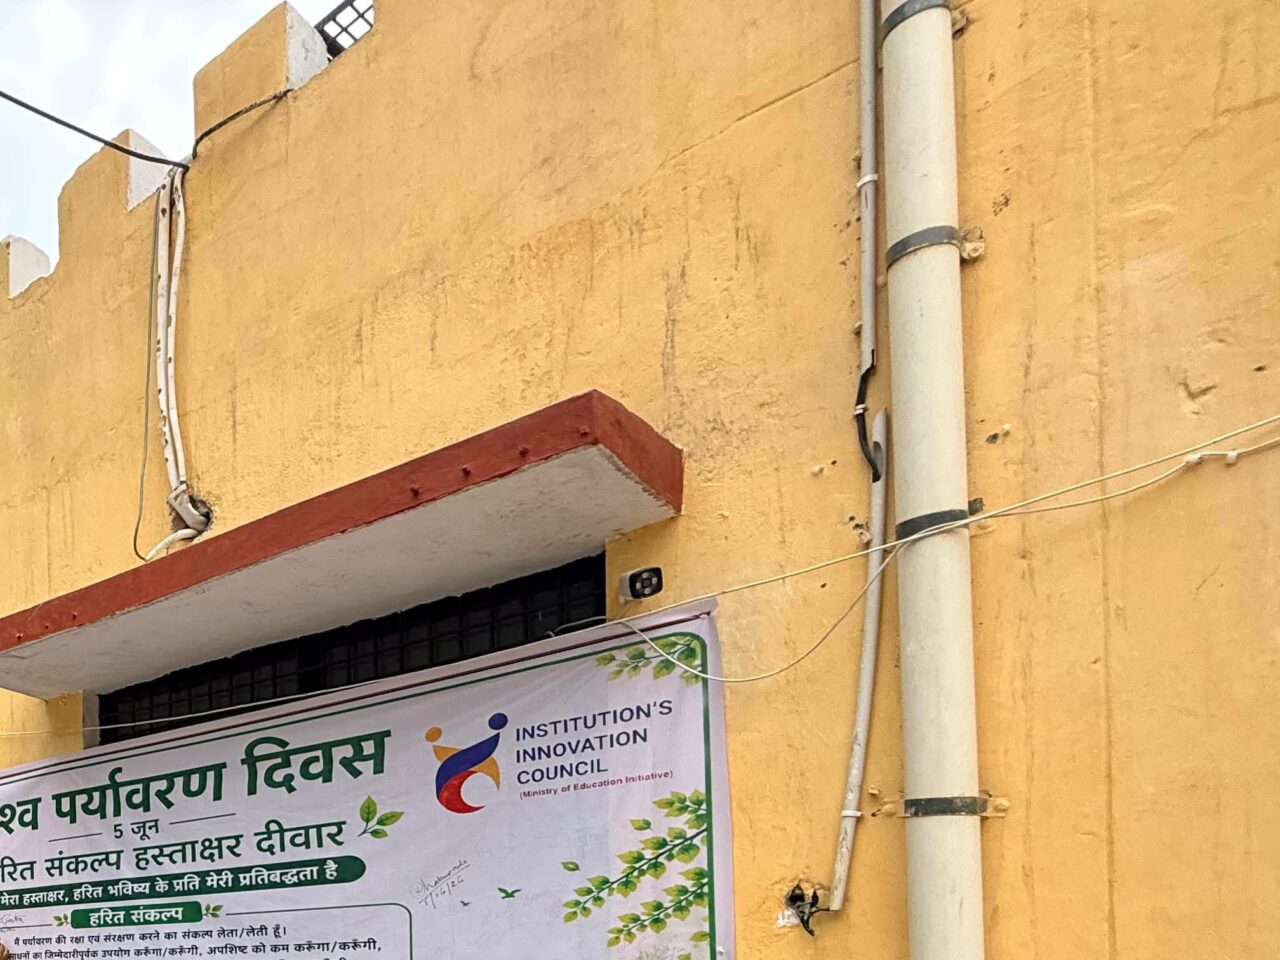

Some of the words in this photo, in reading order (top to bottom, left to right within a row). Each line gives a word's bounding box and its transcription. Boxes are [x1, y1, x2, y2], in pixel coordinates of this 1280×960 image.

[516, 700, 673, 741] INSTITUTION'S
[516, 728, 648, 763] INNOVATION
[54, 762, 227, 824] पर्यावरण
[242, 729, 391, 796] दिवस
[517, 758, 608, 785] COUNCIL
[520, 786, 558, 800] (Ministry
[561, 783, 572, 793] of
[573, 776, 623, 791] Education
[625, 770, 673, 784] Initiative)
[113, 824, 124, 839] 5
[131, 818, 159, 841] जून
[45, 848, 123, 880] संकल्प
[134, 833, 243, 871] हस्ताक्षर
[254, 819, 347, 857] दीवार
[0, 889, 20, 906] मेरा
[22, 886, 69, 905] हस्ताक्षर,
[73, 883, 103, 901] हरित
[107, 879, 150, 898] भविष्य
[153, 877, 170, 893] के
[173, 874, 201, 892] प्रति
[205, 870, 232, 889] मेरी
[239, 864, 319, 889] प्रतिबद्धता
[324, 860, 338, 879] है
[89, 908, 126, 926] हरित
[130, 904, 184, 924] संकल्प
[22, 936, 52, 946] पर्यावरण
[55, 934, 66, 944] की
[70, 935, 85, 944] रक्षा
[88, 934, 100, 944] एवं
[103, 932, 135, 943] संरक्षण
[139, 930, 160, 941] करने
[163, 931, 178, 940] का
[182, 929, 213, 940] संकल्प
[217, 924, 268, 938] लेता/लेती
[32, 951, 42, 960] का
[101, 947, 131, 958] उपयोग
[207, 943, 248, 955] अपशिष्ट
[251, 942, 266, 954] को
[270, 944, 290, 953] कम
